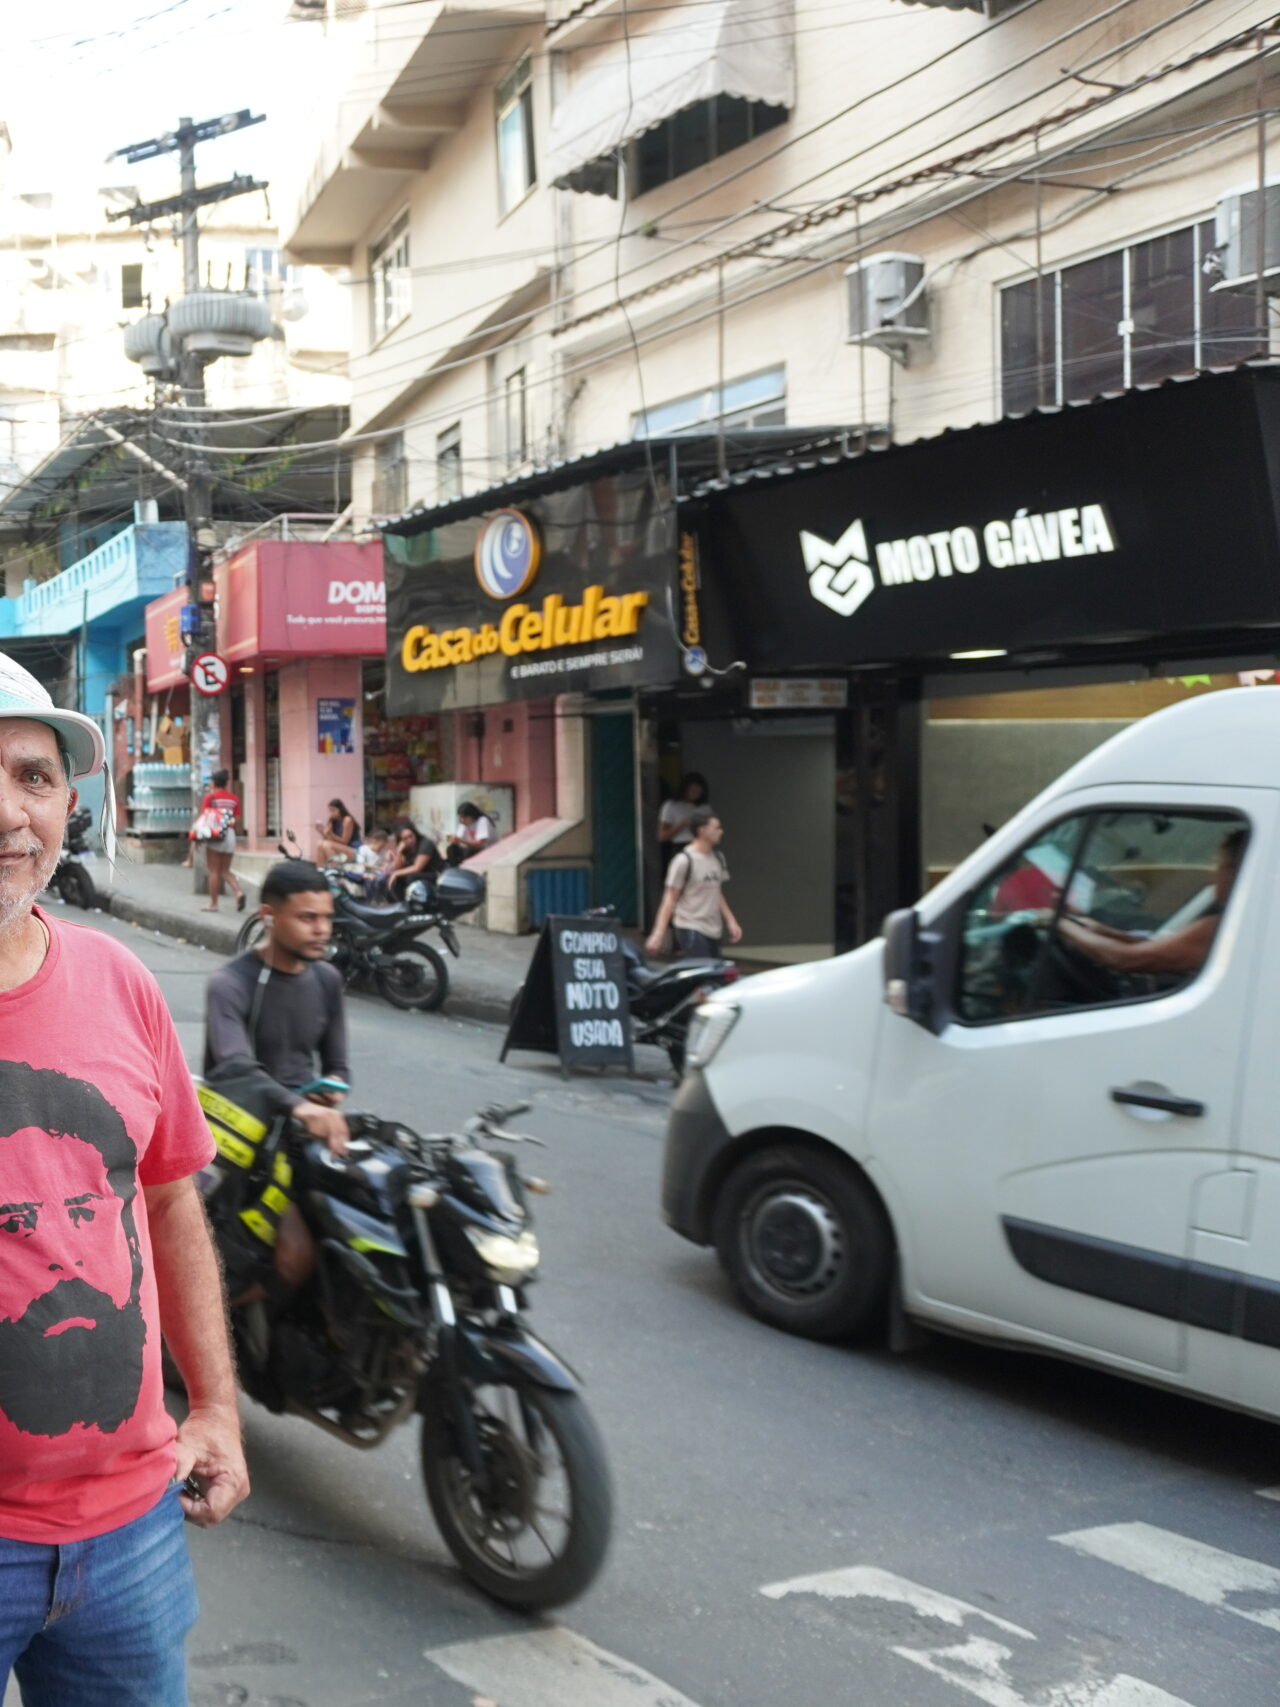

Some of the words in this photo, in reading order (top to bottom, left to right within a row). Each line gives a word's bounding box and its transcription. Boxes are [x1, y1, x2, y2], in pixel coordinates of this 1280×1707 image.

[875, 526, 981, 587] MOTO
[983, 503, 1115, 568] GÁVEA
[402, 624, 473, 673] Casa
[472, 623, 501, 656] do
[499, 585, 649, 656] Celular
[560, 930, 618, 954] COMPRO
[574, 957, 606, 979] SUA
[565, 981, 619, 1009] MOTO
[570, 1019, 624, 1047] USADA
